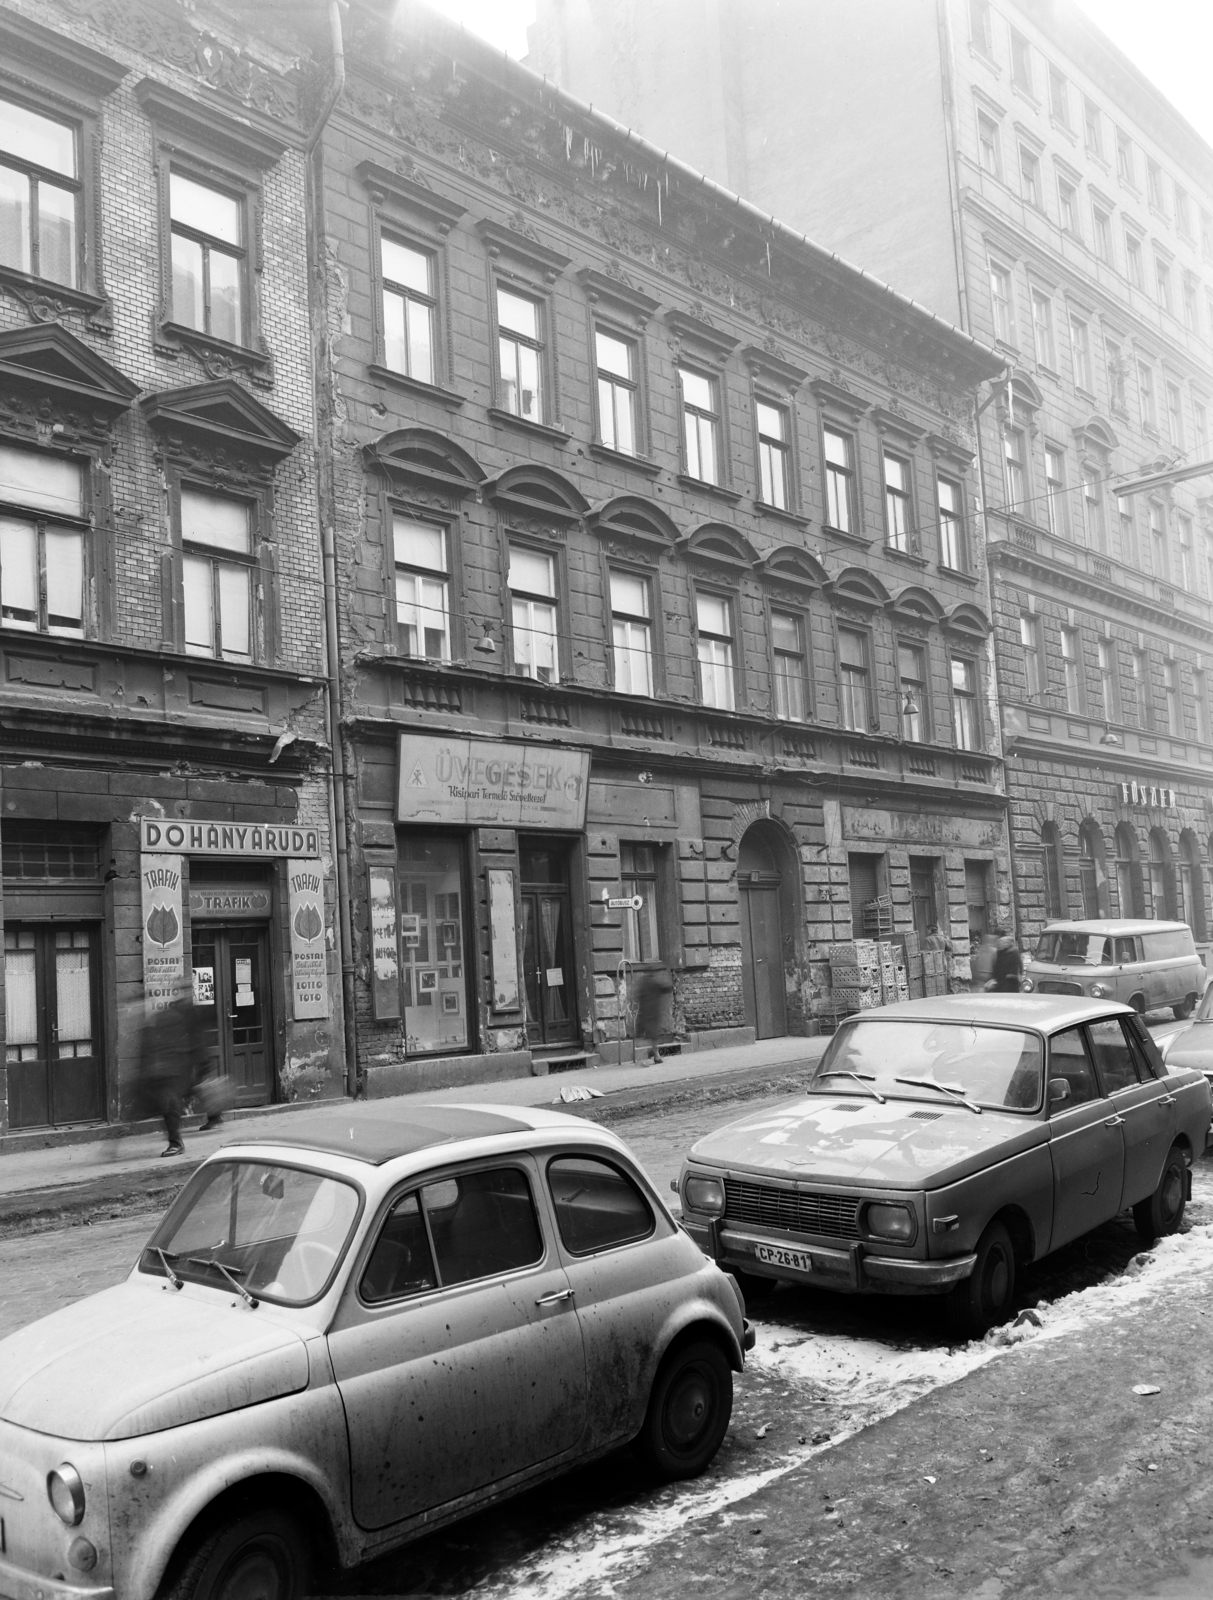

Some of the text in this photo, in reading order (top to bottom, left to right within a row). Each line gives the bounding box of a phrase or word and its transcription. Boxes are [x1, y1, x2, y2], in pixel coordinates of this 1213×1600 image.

[435, 747, 562, 792] ÜVEGESEK
[448, 785, 480, 800] Kisipari
[509, 790, 547, 804] Szövetkezet
[143, 868, 180, 892] TRAFIK
[291, 872, 321, 894] TRAFIK
[204, 897, 252, 909] TRAFIK
[147, 957, 179, 966] POSTAI
[148, 988, 180, 998] LOTTO
[297, 981, 323, 990] LOTTO
[299, 993, 322, 1002] TOTO
[760, 1247, 808, 1270] CP-26-81
